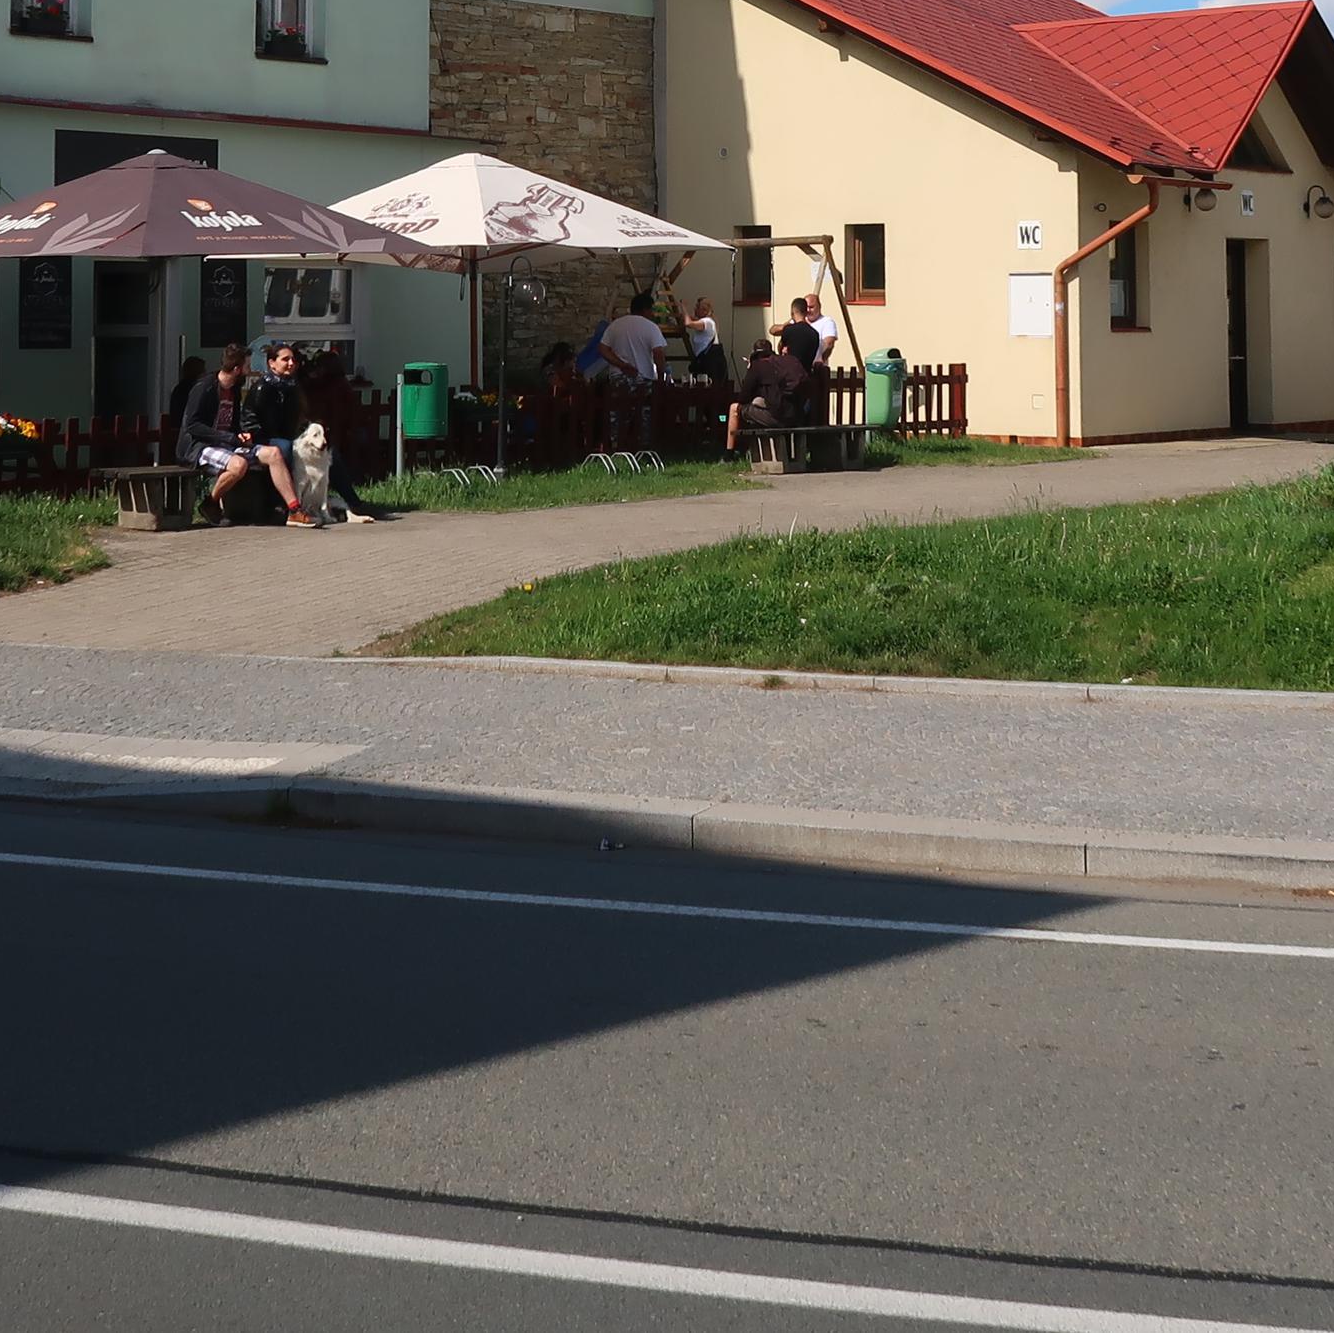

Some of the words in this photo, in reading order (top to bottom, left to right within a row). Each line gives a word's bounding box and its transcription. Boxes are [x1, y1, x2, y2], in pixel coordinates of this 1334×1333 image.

[1242, 193, 1255, 213] WC
[180, 210, 264, 232] kofola
[1019, 225, 1042, 246] WC
